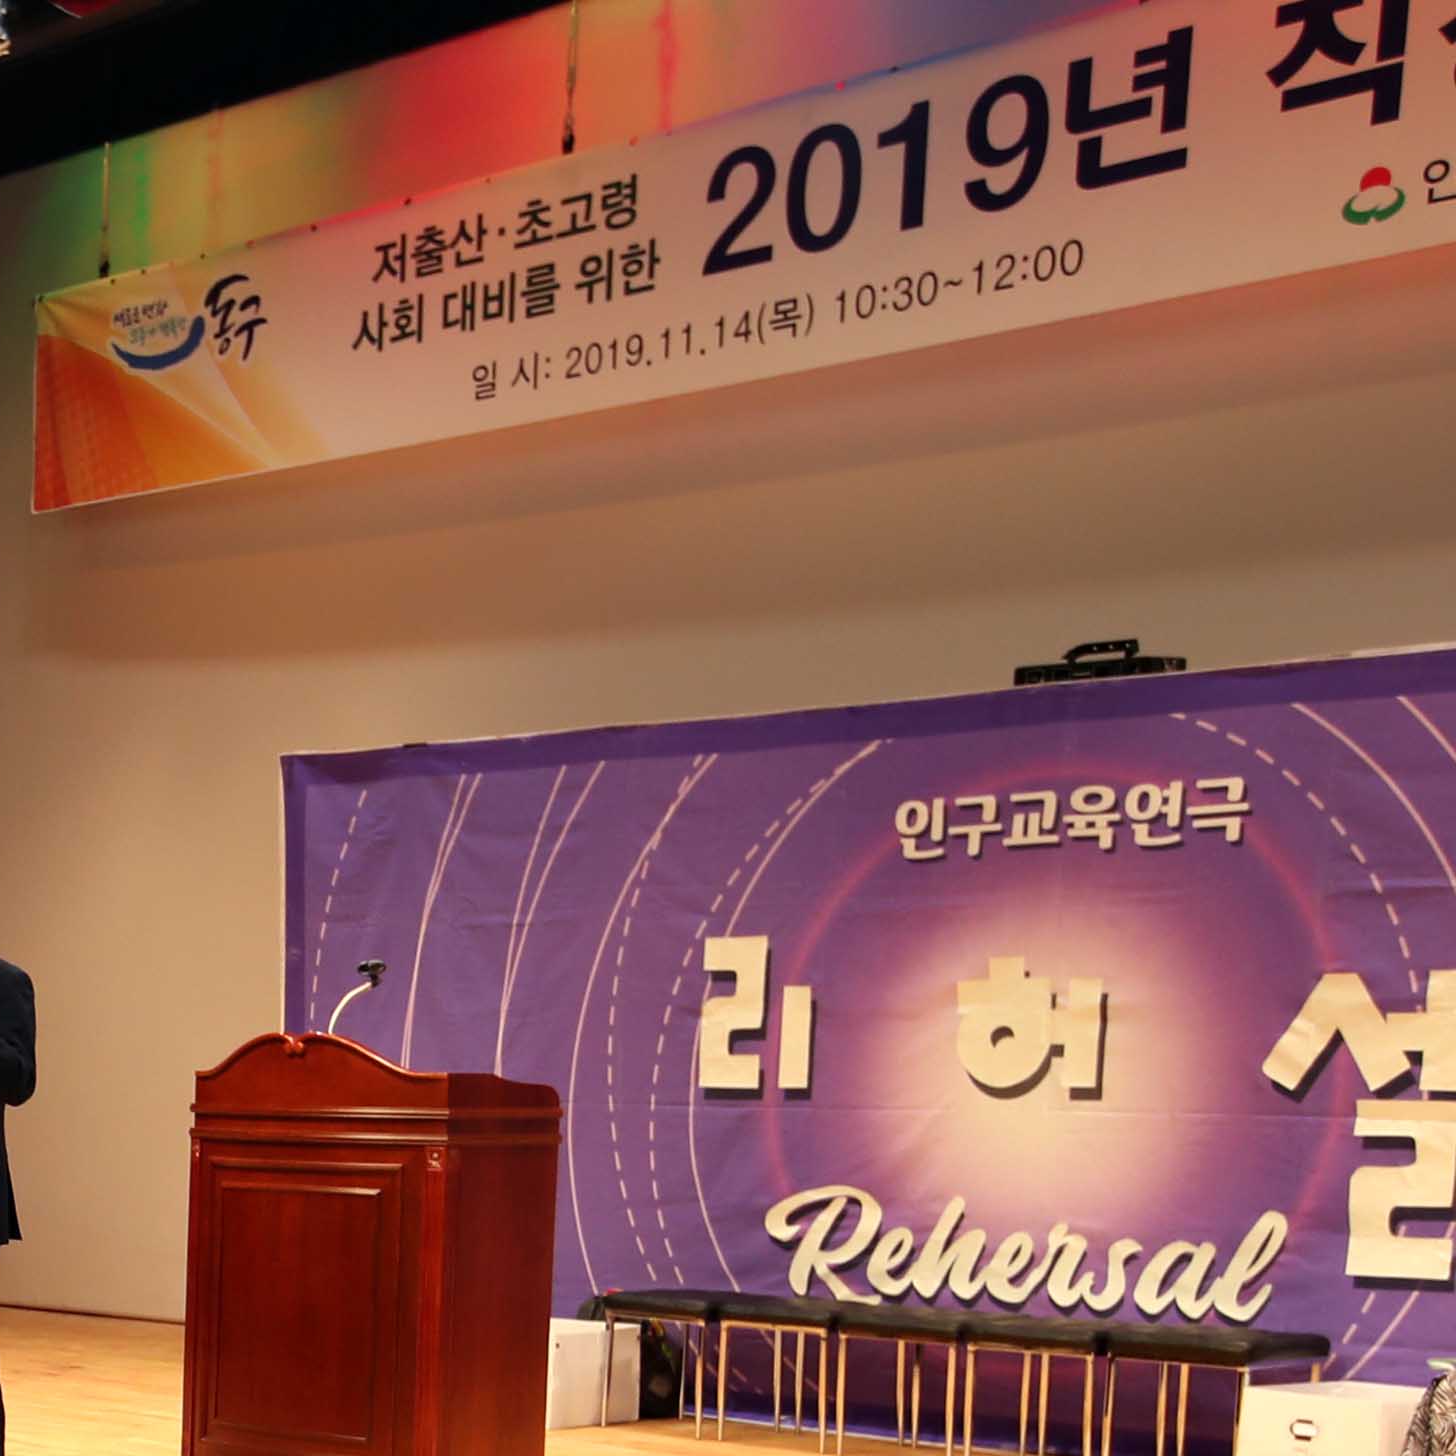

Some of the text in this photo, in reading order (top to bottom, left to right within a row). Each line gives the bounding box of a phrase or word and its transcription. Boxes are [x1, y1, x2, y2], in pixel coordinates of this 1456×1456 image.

[702, 0, 1456, 276] 2019년 직
[203, 273, 269, 361] 동구
[352, 238, 662, 352] 사회 대비를 위한
[565, 292, 816, 380] 2019.11.14(목)
[833, 239, 1085, 325] 10:30~12:00
[893, 776, 1250, 860] 인구교육연극
[699, 935, 814, 1091] 리
[956, 956, 1108, 1099] 허
[765, 1185, 1288, 1323] Rehersal
